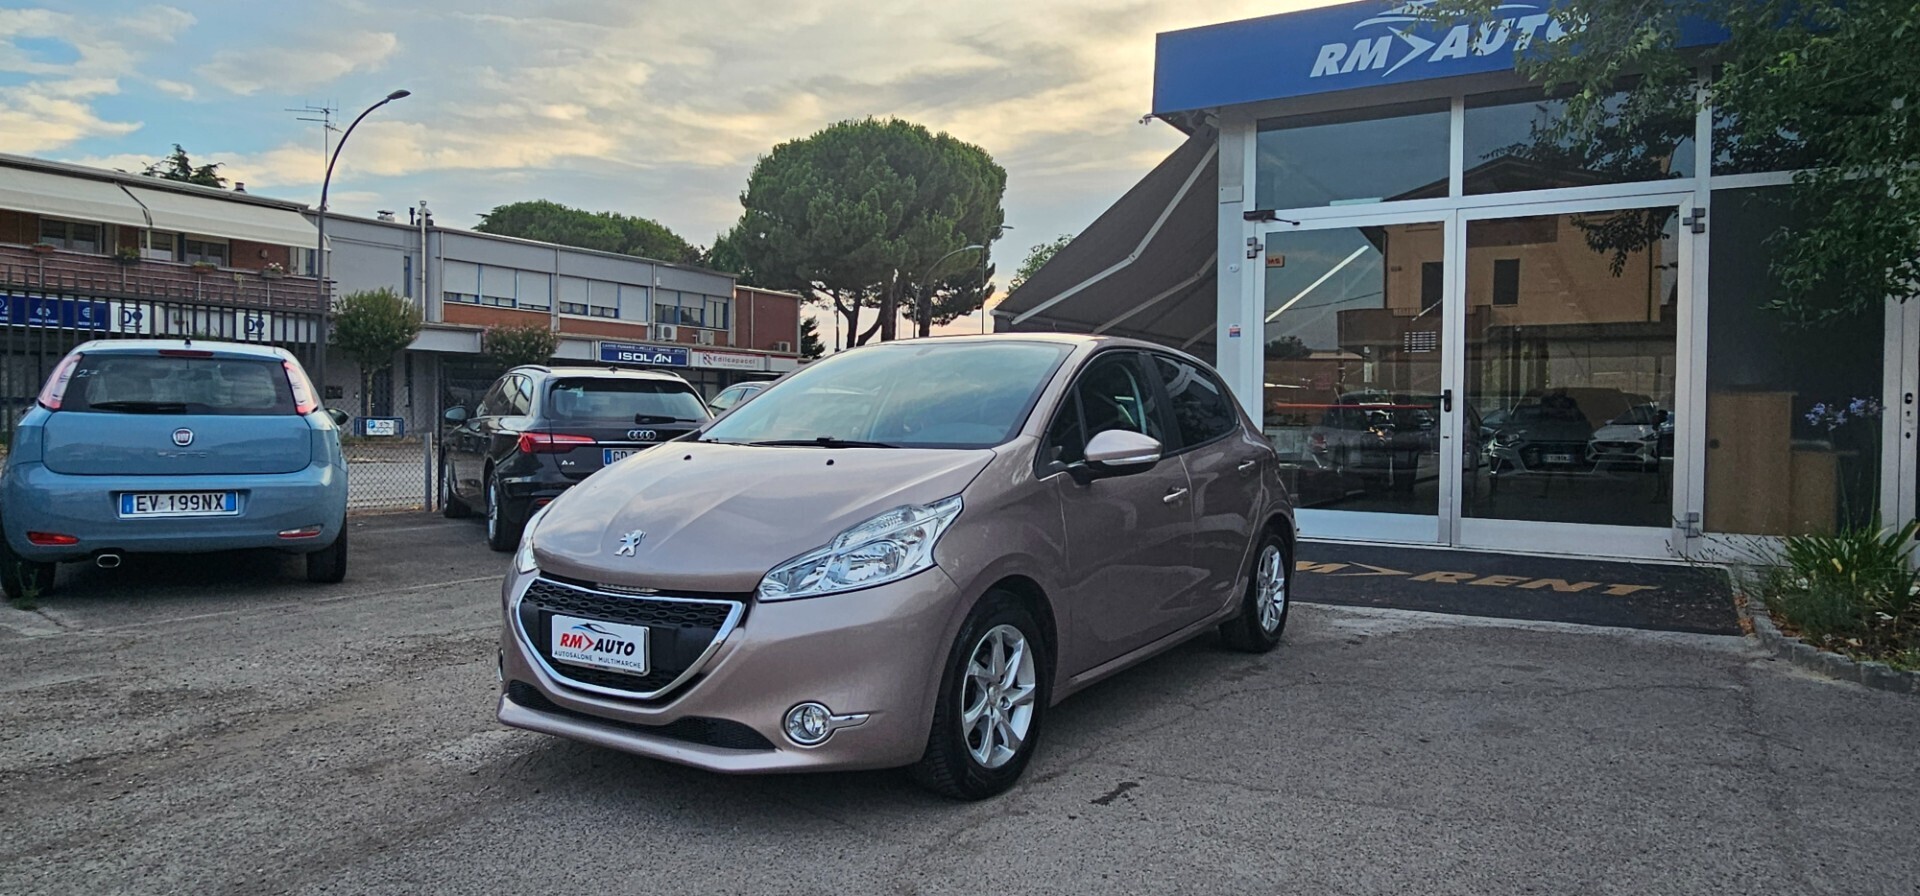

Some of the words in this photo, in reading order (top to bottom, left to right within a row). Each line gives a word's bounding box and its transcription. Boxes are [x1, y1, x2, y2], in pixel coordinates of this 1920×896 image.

[1310, 35, 1393, 78] RM
[618, 351, 672, 364] ISOLAN
[136, 495, 159, 512] EV
[168, 494, 224, 511] 199NX
[1408, 570, 1661, 596] RENT
[560, 632, 583, 649] RM
[593, 638, 635, 656] AUTO
[554, 650, 593, 662] AUTOSALONE
[598, 656, 641, 669] MULTIMARCHE
